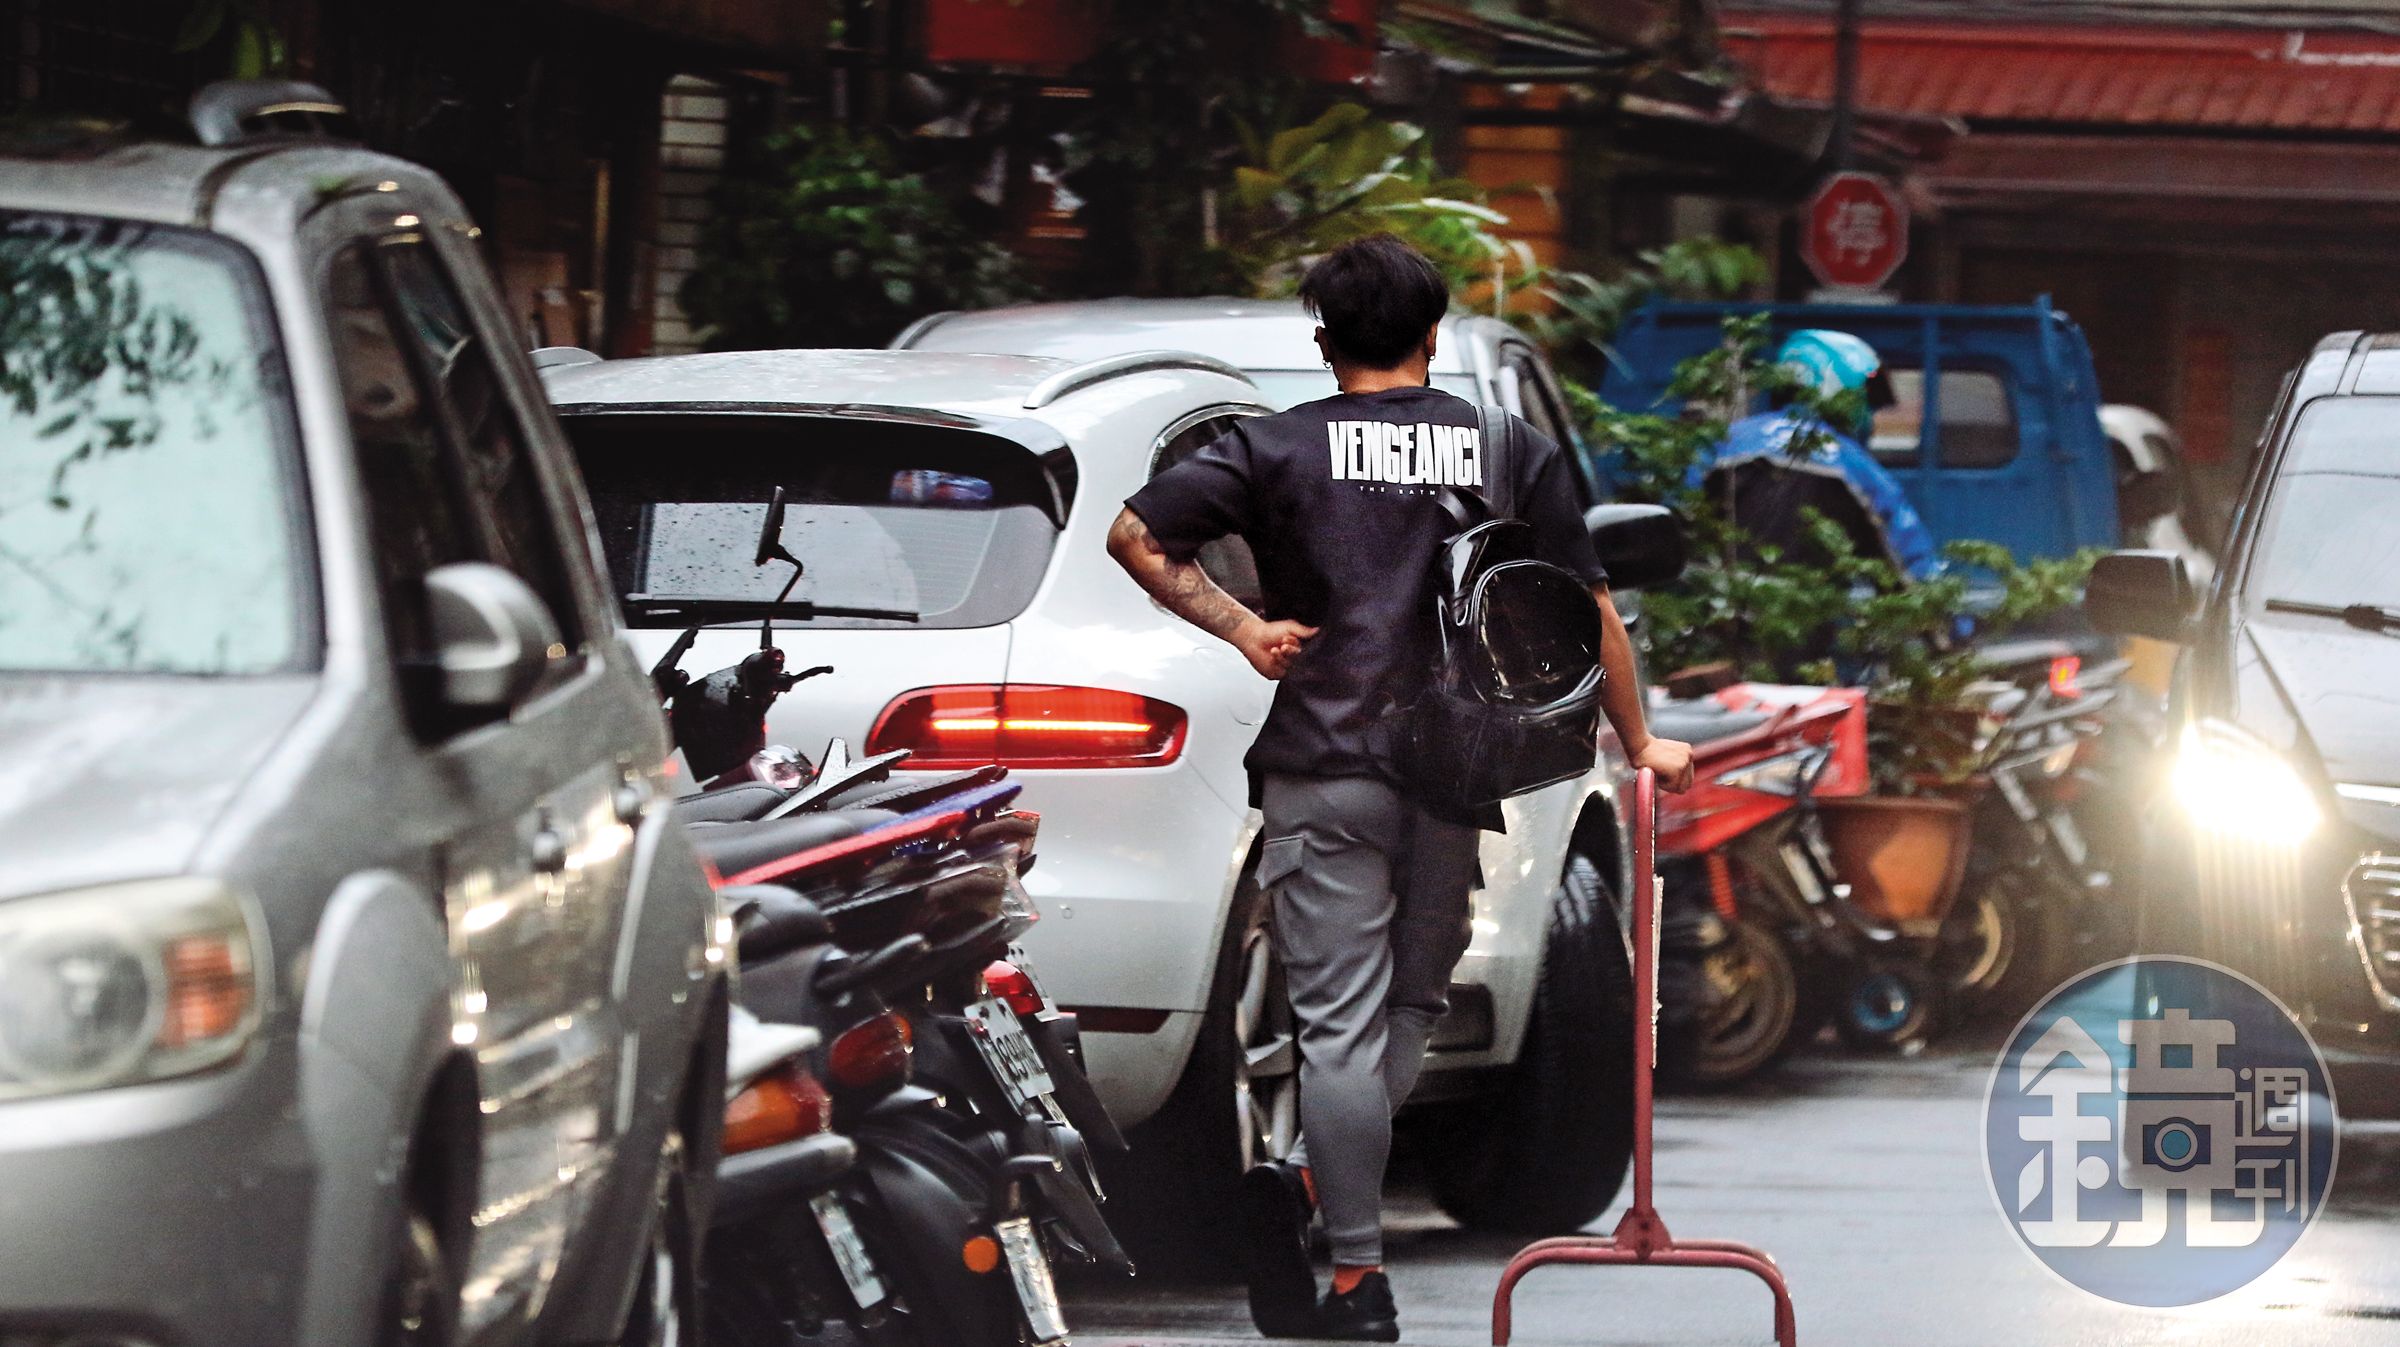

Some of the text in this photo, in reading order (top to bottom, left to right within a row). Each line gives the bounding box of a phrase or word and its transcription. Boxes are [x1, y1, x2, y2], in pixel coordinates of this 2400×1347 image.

[1826, 199, 1887, 266] 停
[1359, 485, 1436, 496] THE BATM
